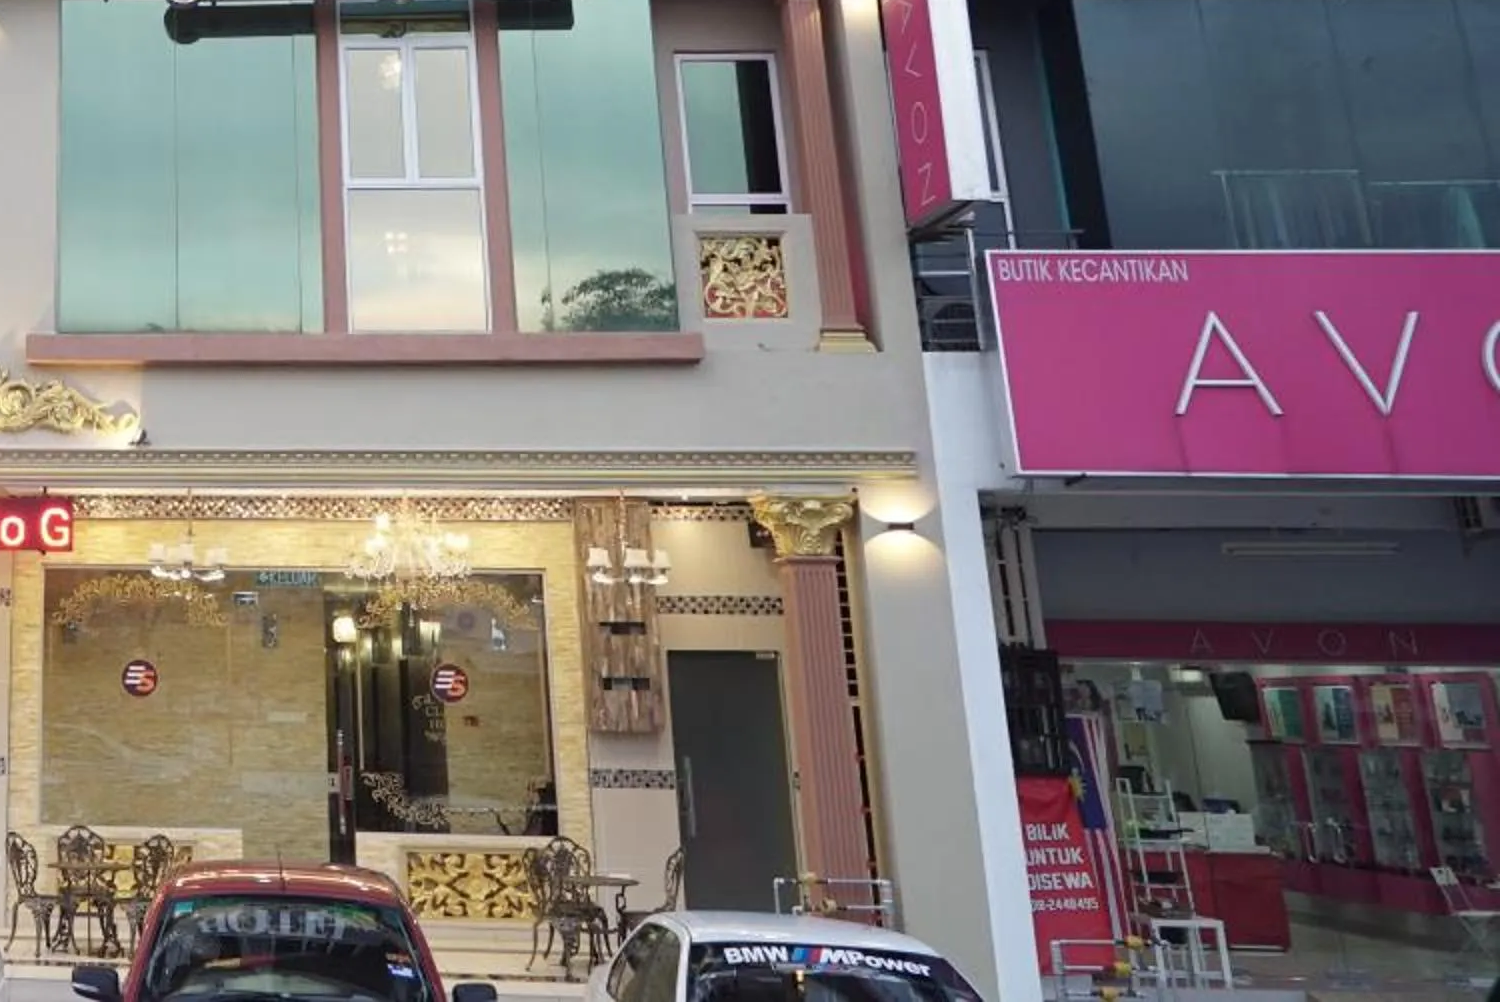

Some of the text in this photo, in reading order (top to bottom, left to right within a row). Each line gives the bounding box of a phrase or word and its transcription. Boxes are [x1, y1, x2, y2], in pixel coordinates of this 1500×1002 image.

[999, 259, 1189, 282] BUTIK KECANTIKAN
[40, 507, 71, 547] G
[1191, 627, 1418, 657] AVON
[1026, 823, 1069, 840] BILIK
[723, 947, 789, 964] BMW
